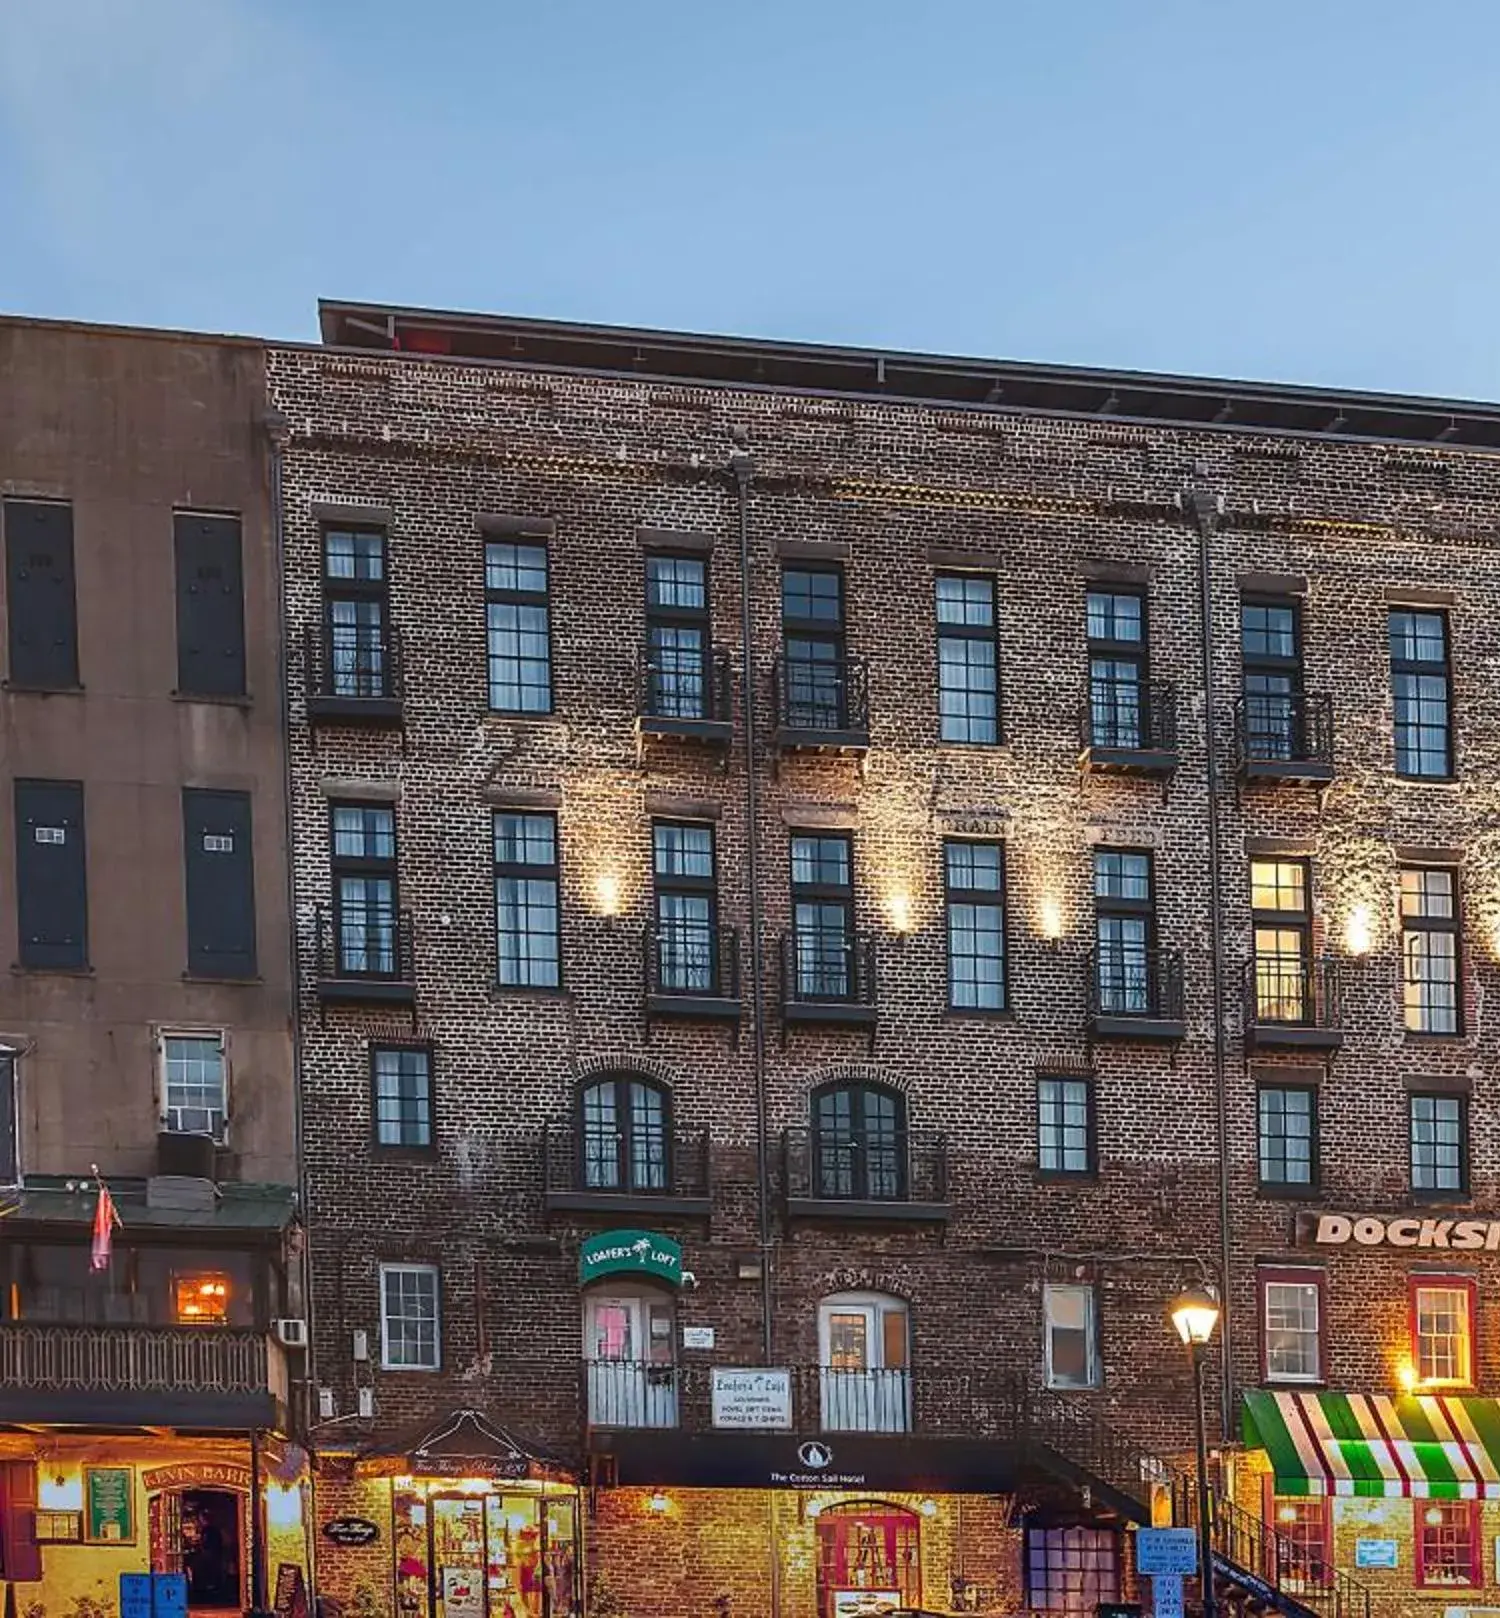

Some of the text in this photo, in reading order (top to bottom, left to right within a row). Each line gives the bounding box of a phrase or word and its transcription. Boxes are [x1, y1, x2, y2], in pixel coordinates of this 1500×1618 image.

[651, 1250, 676, 1267] LOFT
[770, 1473, 865, 1484] The Cotton Sail Hotel
